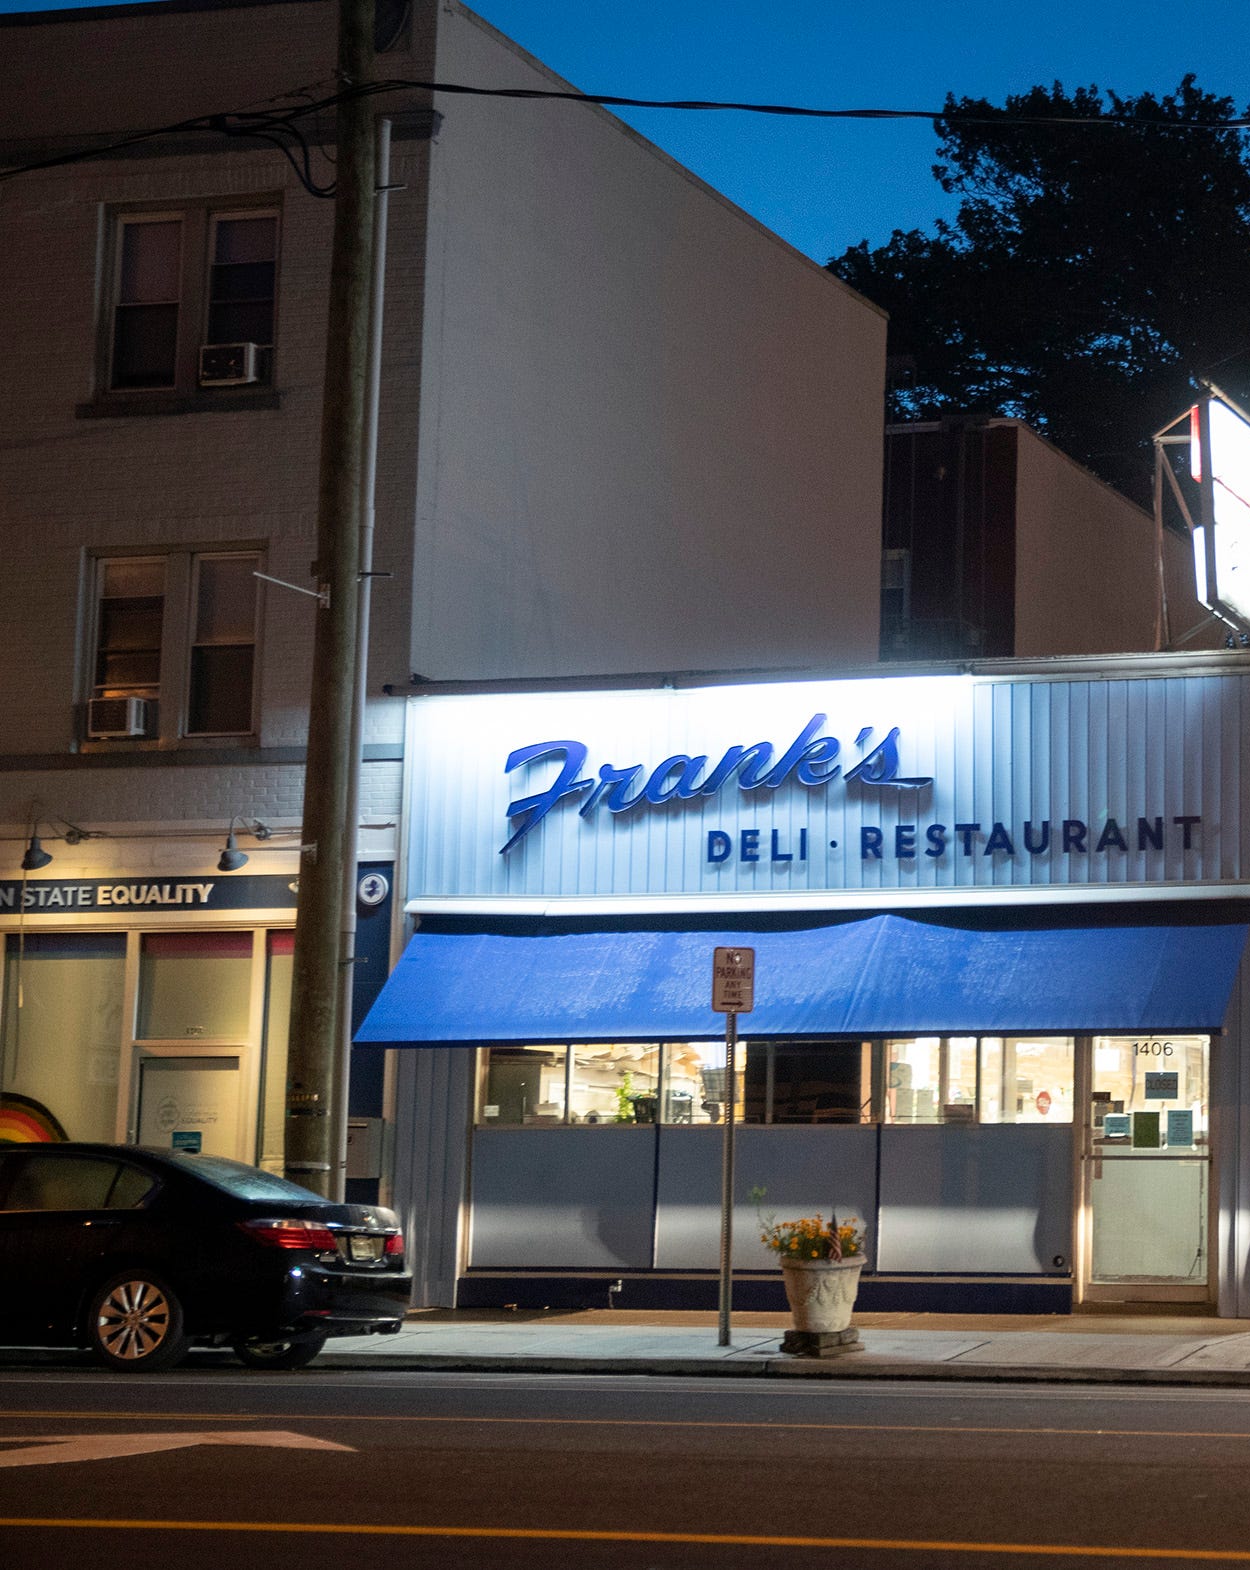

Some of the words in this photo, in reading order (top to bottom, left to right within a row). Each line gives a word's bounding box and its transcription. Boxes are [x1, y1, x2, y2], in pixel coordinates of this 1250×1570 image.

[499, 713, 934, 854] Frank's
[707, 829, 807, 863] DELI
[861, 816, 1201, 860] RESTAURANT
[22, 886, 93, 907] STATE
[96, 883, 215, 905] EQUALITY
[726, 952, 743, 965] NO
[716, 966, 752, 979] PARKING
[725, 980, 741, 989] ANY
[723, 990, 742, 999] TIME
[1133, 1042, 1174, 1056] 1406
[1146, 1079, 1177, 1090] CLOSED
